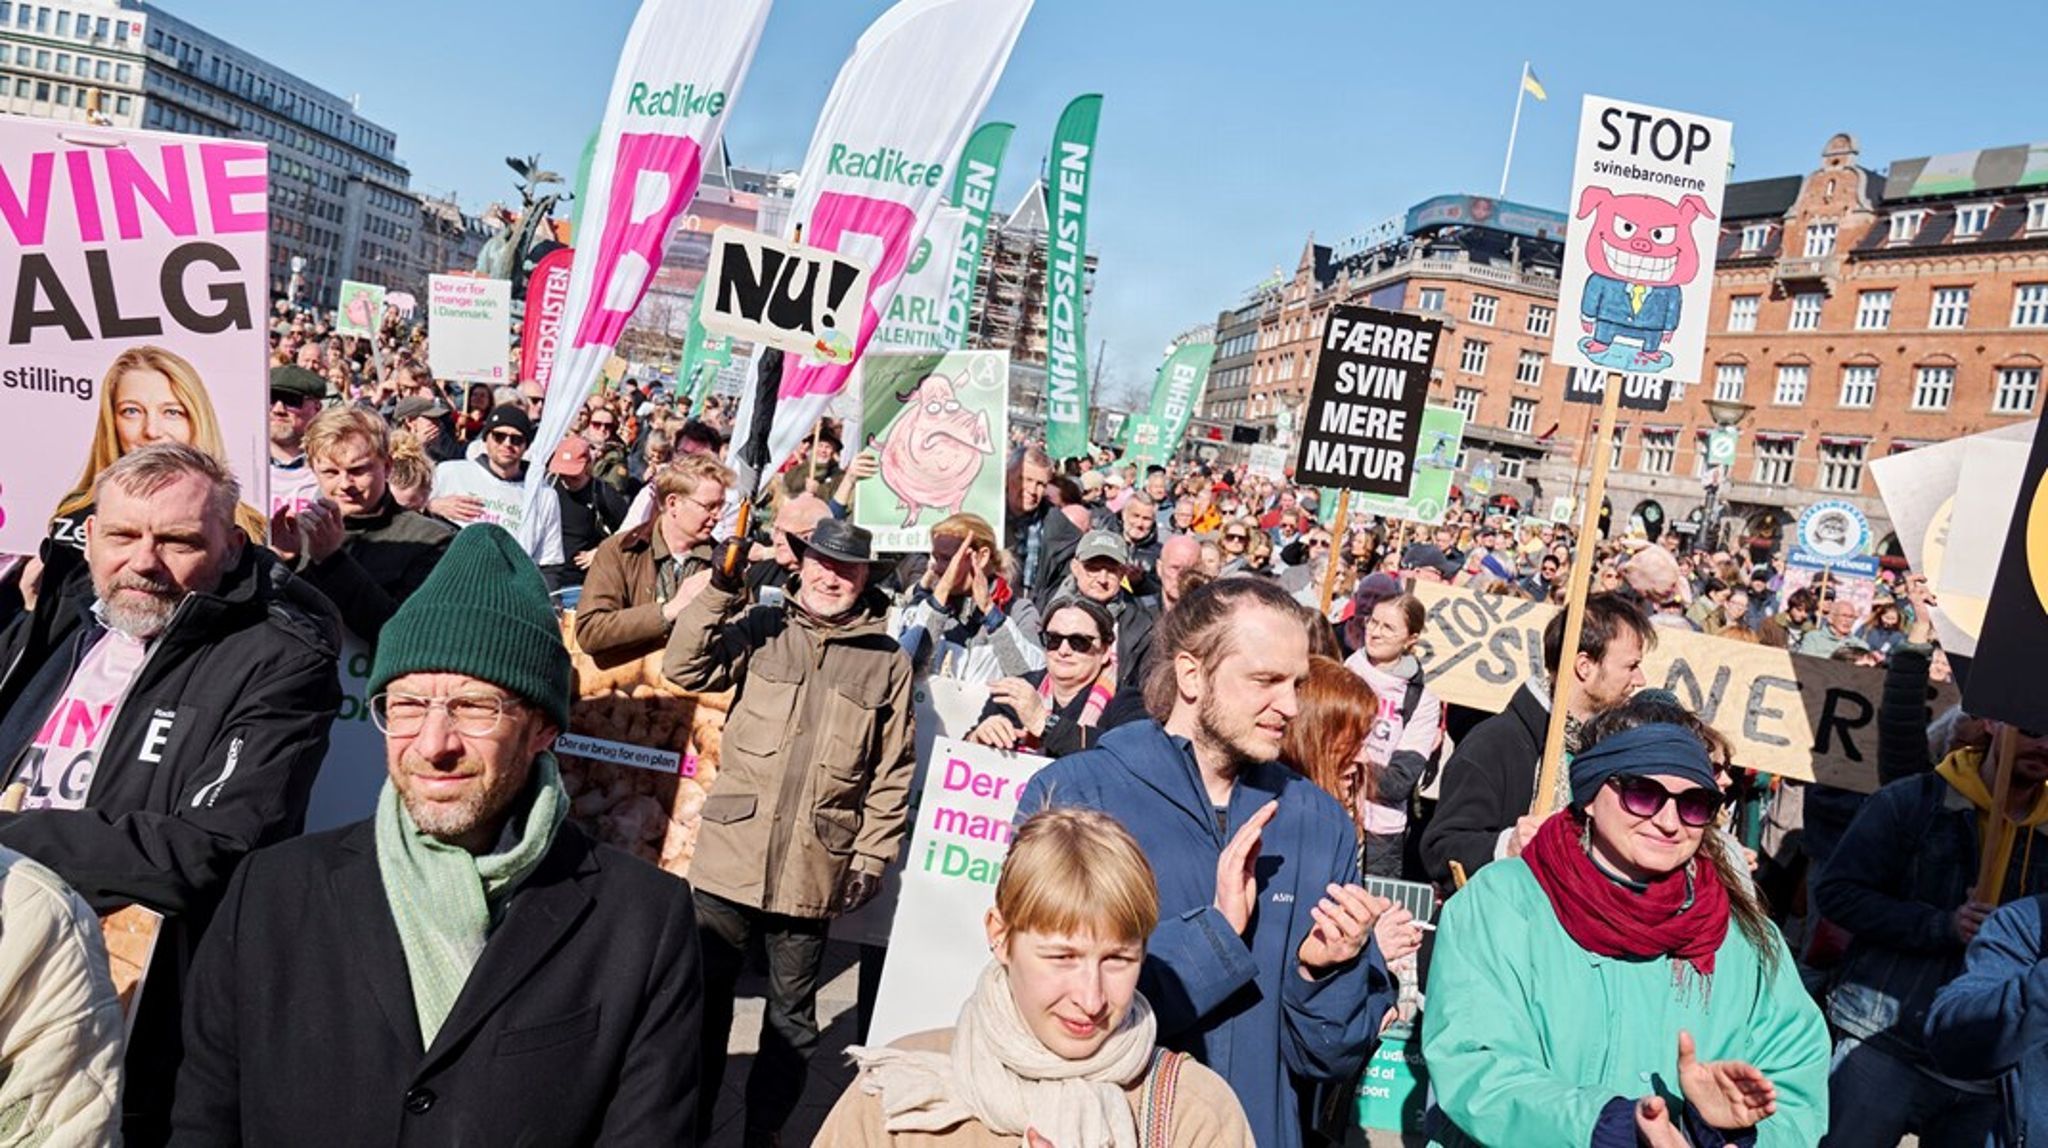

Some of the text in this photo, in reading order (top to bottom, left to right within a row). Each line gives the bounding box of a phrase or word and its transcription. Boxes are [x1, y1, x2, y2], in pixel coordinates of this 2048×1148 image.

[1598, 106, 1712, 166] STOP
[1593, 159, 1706, 193] svinebaronerne
[9, 241, 253, 345] ALG
[715, 242, 861, 336] NU!
[1050, 141, 1090, 424] ENHEDSLISTEN
[1326, 317, 1433, 365] FÆRRE
[3, 366, 94, 401] stilling
[1334, 361, 1408, 401] SVIN
[1571, 366, 1664, 401] NAUR
[1319, 400, 1408, 443] MERE
[1304, 439, 1406, 483] NATUR
[558, 736, 577, 750] Der
[579, 742, 591, 752] er
[591, 741, 617, 760] brug
[619, 747, 634, 761] for
[635, 752, 650, 764] en
[650, 754, 677, 769] plan
[942, 758, 1010, 800] Der
[924, 840, 937, 872] i
